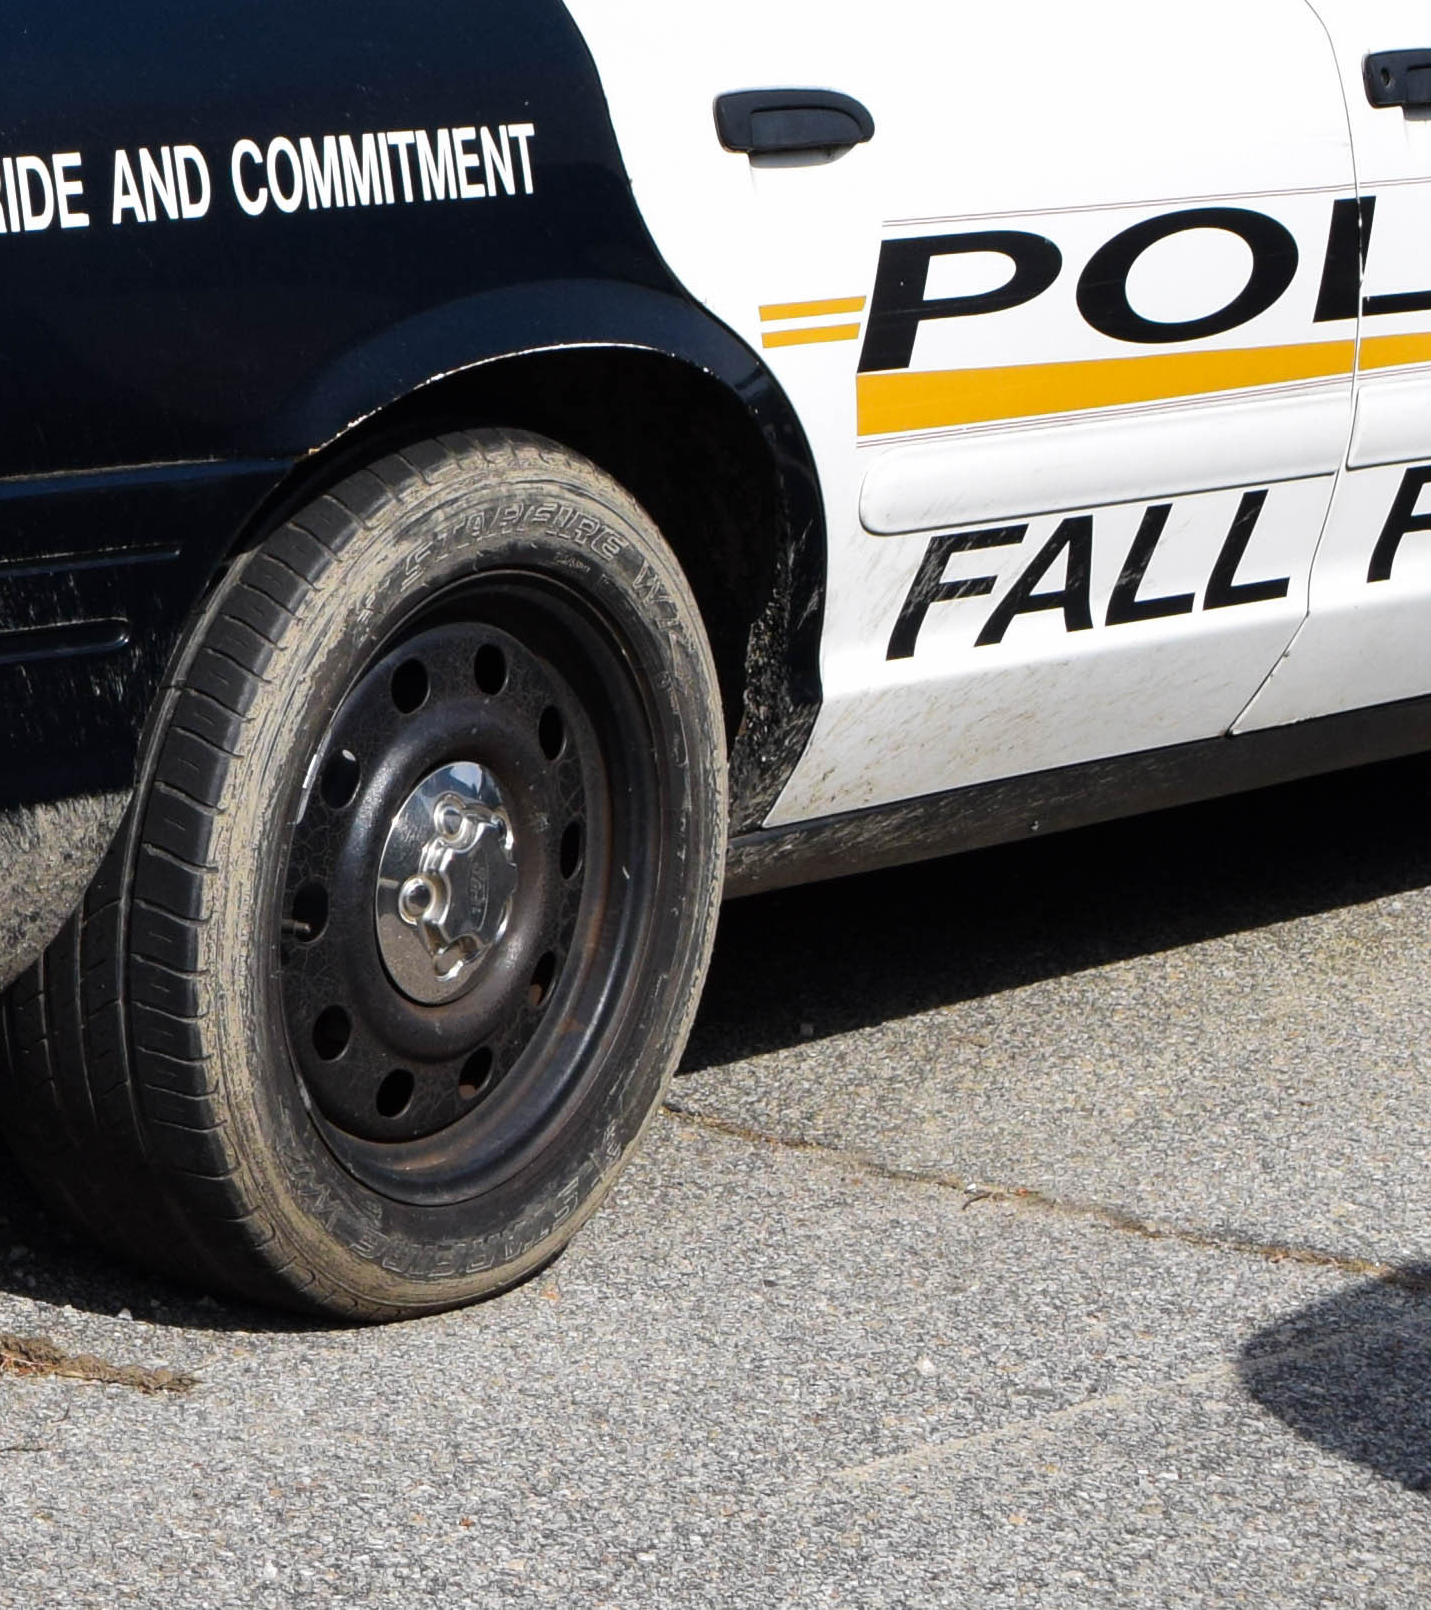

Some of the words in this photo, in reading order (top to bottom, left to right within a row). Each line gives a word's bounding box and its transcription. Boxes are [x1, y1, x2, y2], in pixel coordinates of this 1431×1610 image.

[112, 144, 211, 225] AND
[231, 123, 535, 216] COMMITMENT
[886, 489, 1290, 660] FALL
